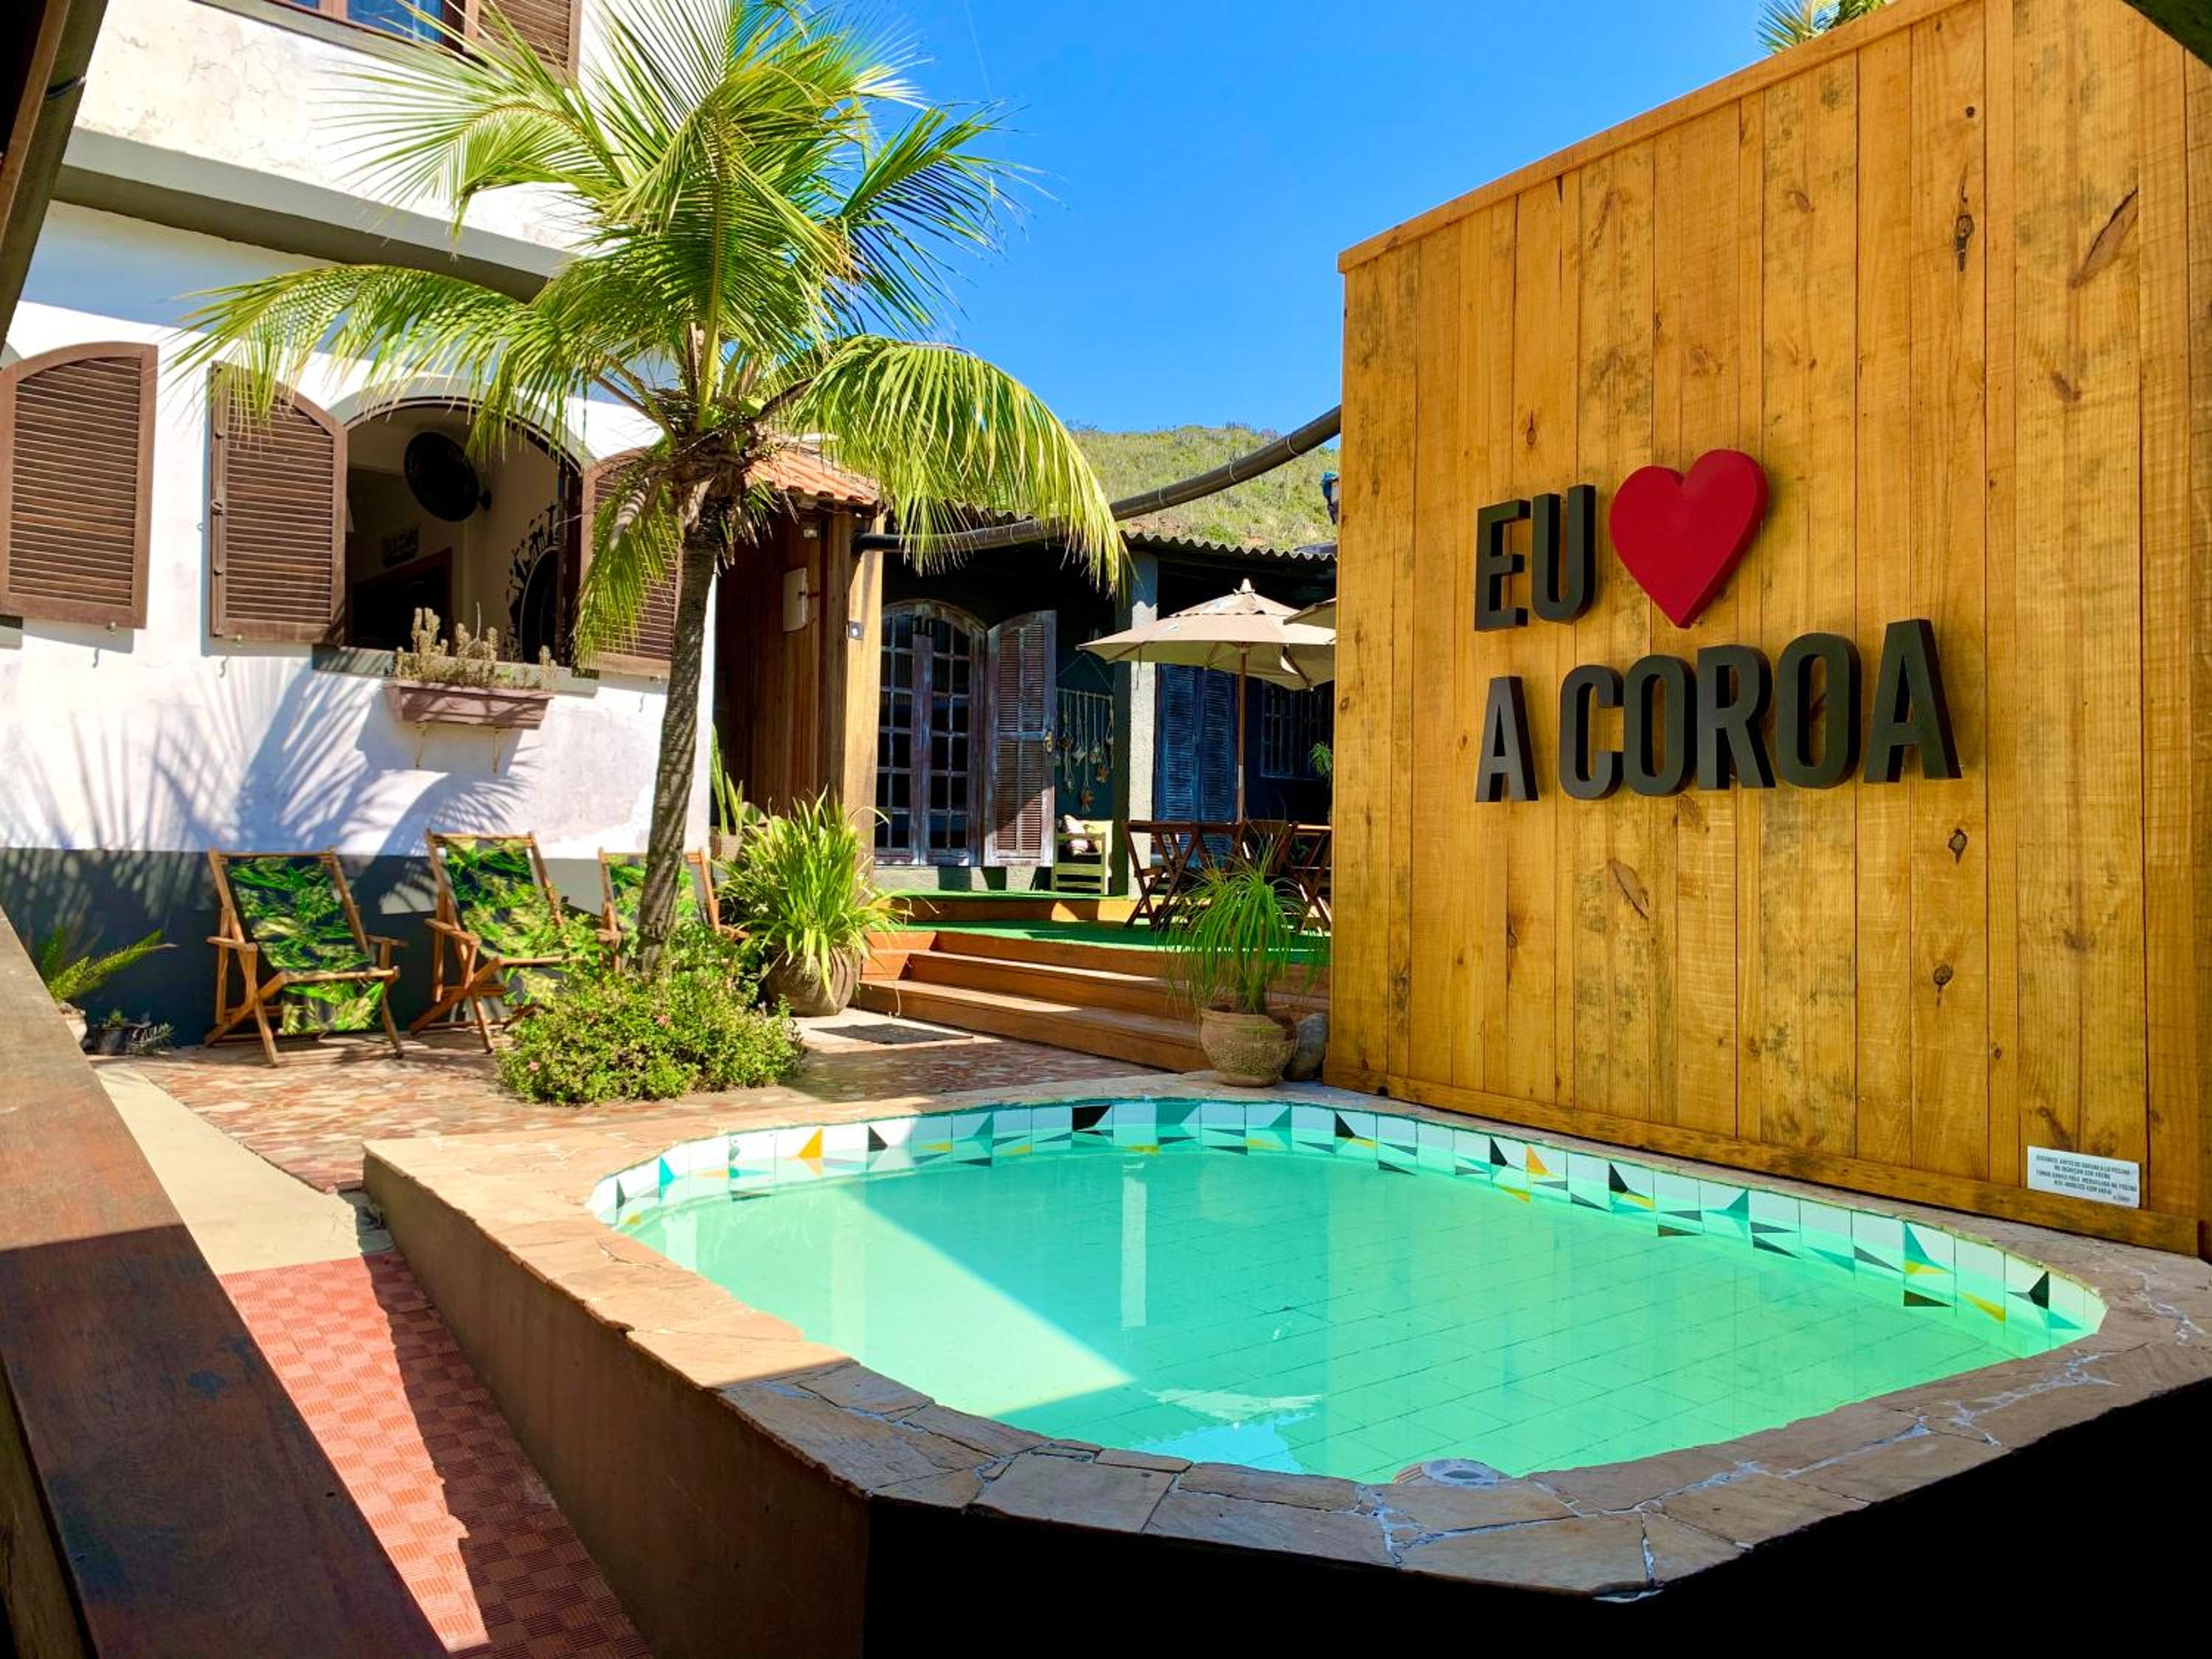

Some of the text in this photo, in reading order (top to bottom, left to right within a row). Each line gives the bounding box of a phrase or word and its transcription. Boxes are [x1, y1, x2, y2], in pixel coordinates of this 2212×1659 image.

[1475, 484, 1596, 632] EU
[1475, 619, 1962, 803] A COROA
